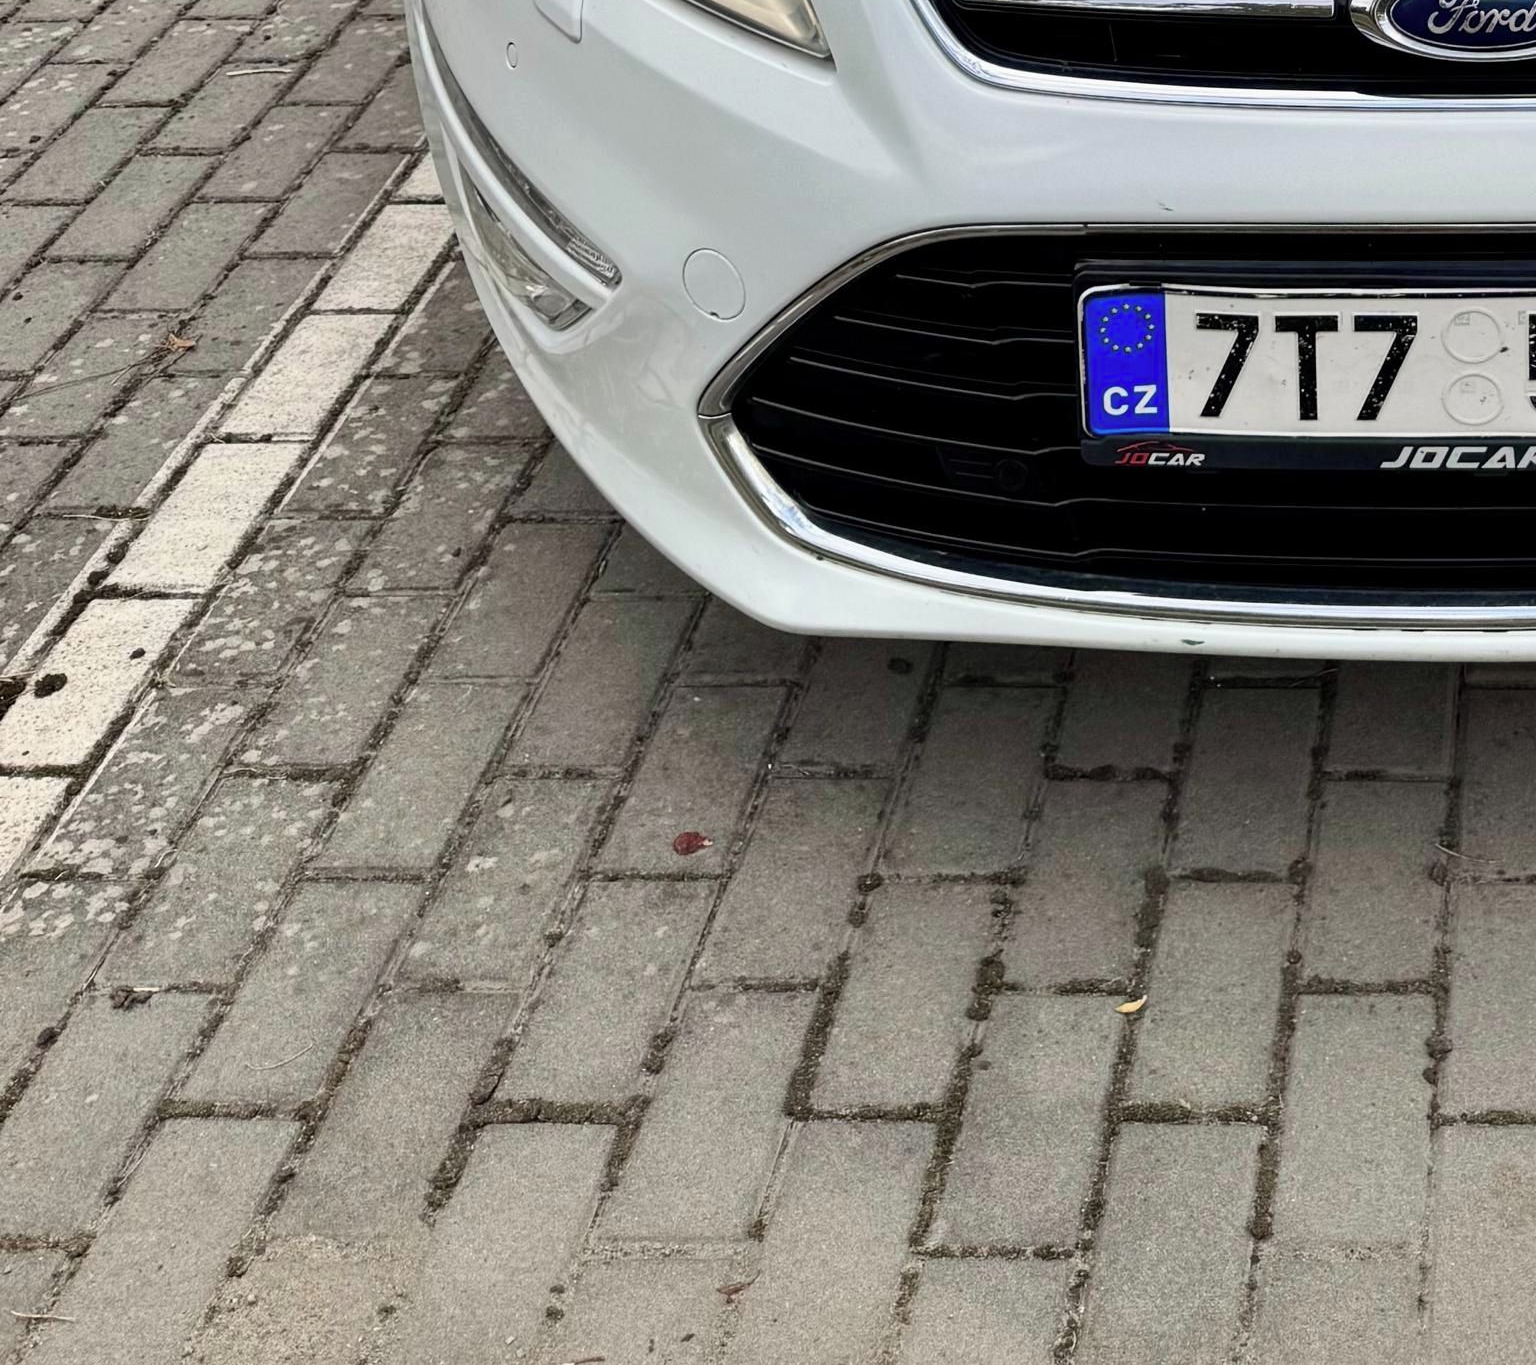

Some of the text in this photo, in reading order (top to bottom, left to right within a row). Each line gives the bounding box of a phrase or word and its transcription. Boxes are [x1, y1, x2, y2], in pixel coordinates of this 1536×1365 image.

[1195, 312, 1418, 421] 7T7
[1103, 384, 1158, 416] CZ
[1114, 452, 1206, 467] JOCAR
